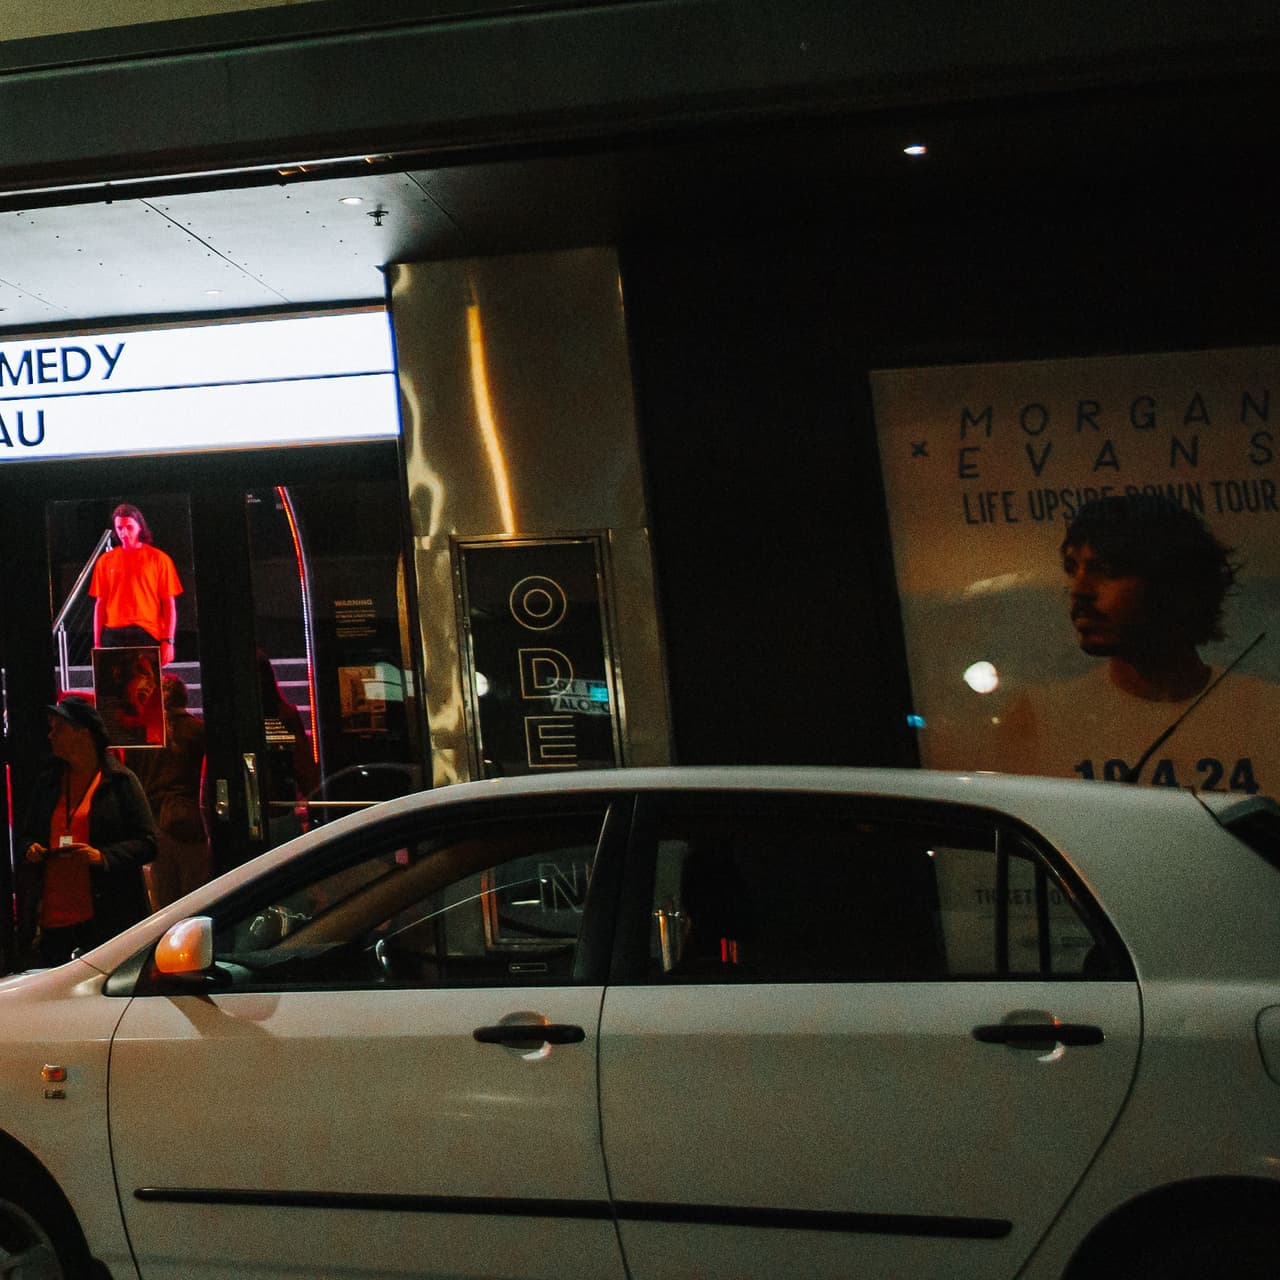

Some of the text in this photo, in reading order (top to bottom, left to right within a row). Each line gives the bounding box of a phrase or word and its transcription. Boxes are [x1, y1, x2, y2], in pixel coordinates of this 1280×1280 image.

[959, 390, 1270, 439] MORGAN
[958, 431, 1274, 479] EVANS
[962, 490, 1017, 524] LIFE
[1210, 478, 1278, 513] TOUR
